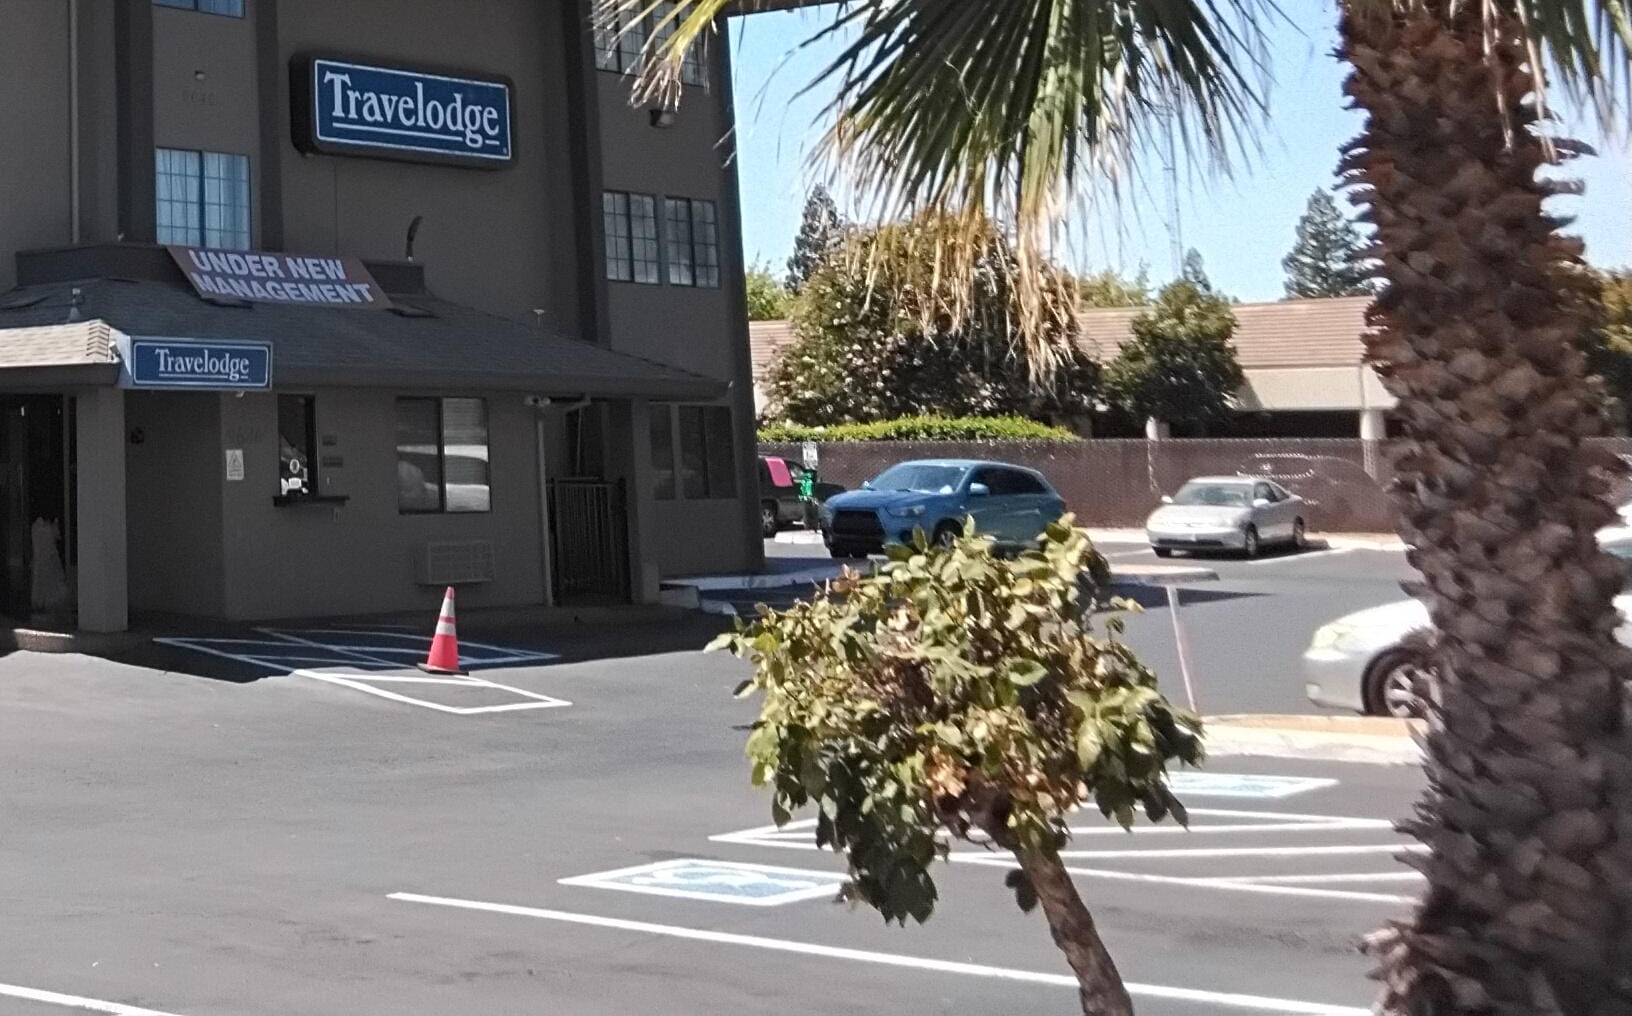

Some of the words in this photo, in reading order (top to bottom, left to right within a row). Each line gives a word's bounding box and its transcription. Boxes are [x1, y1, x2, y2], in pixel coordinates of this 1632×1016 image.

[323, 70, 500, 148] Travelodge
[188, 249, 286, 278] UNDER
[285, 256, 346, 280] NEW
[190, 272, 374, 303] MANAGEMENT
[155, 348, 249, 381] Travelodge
